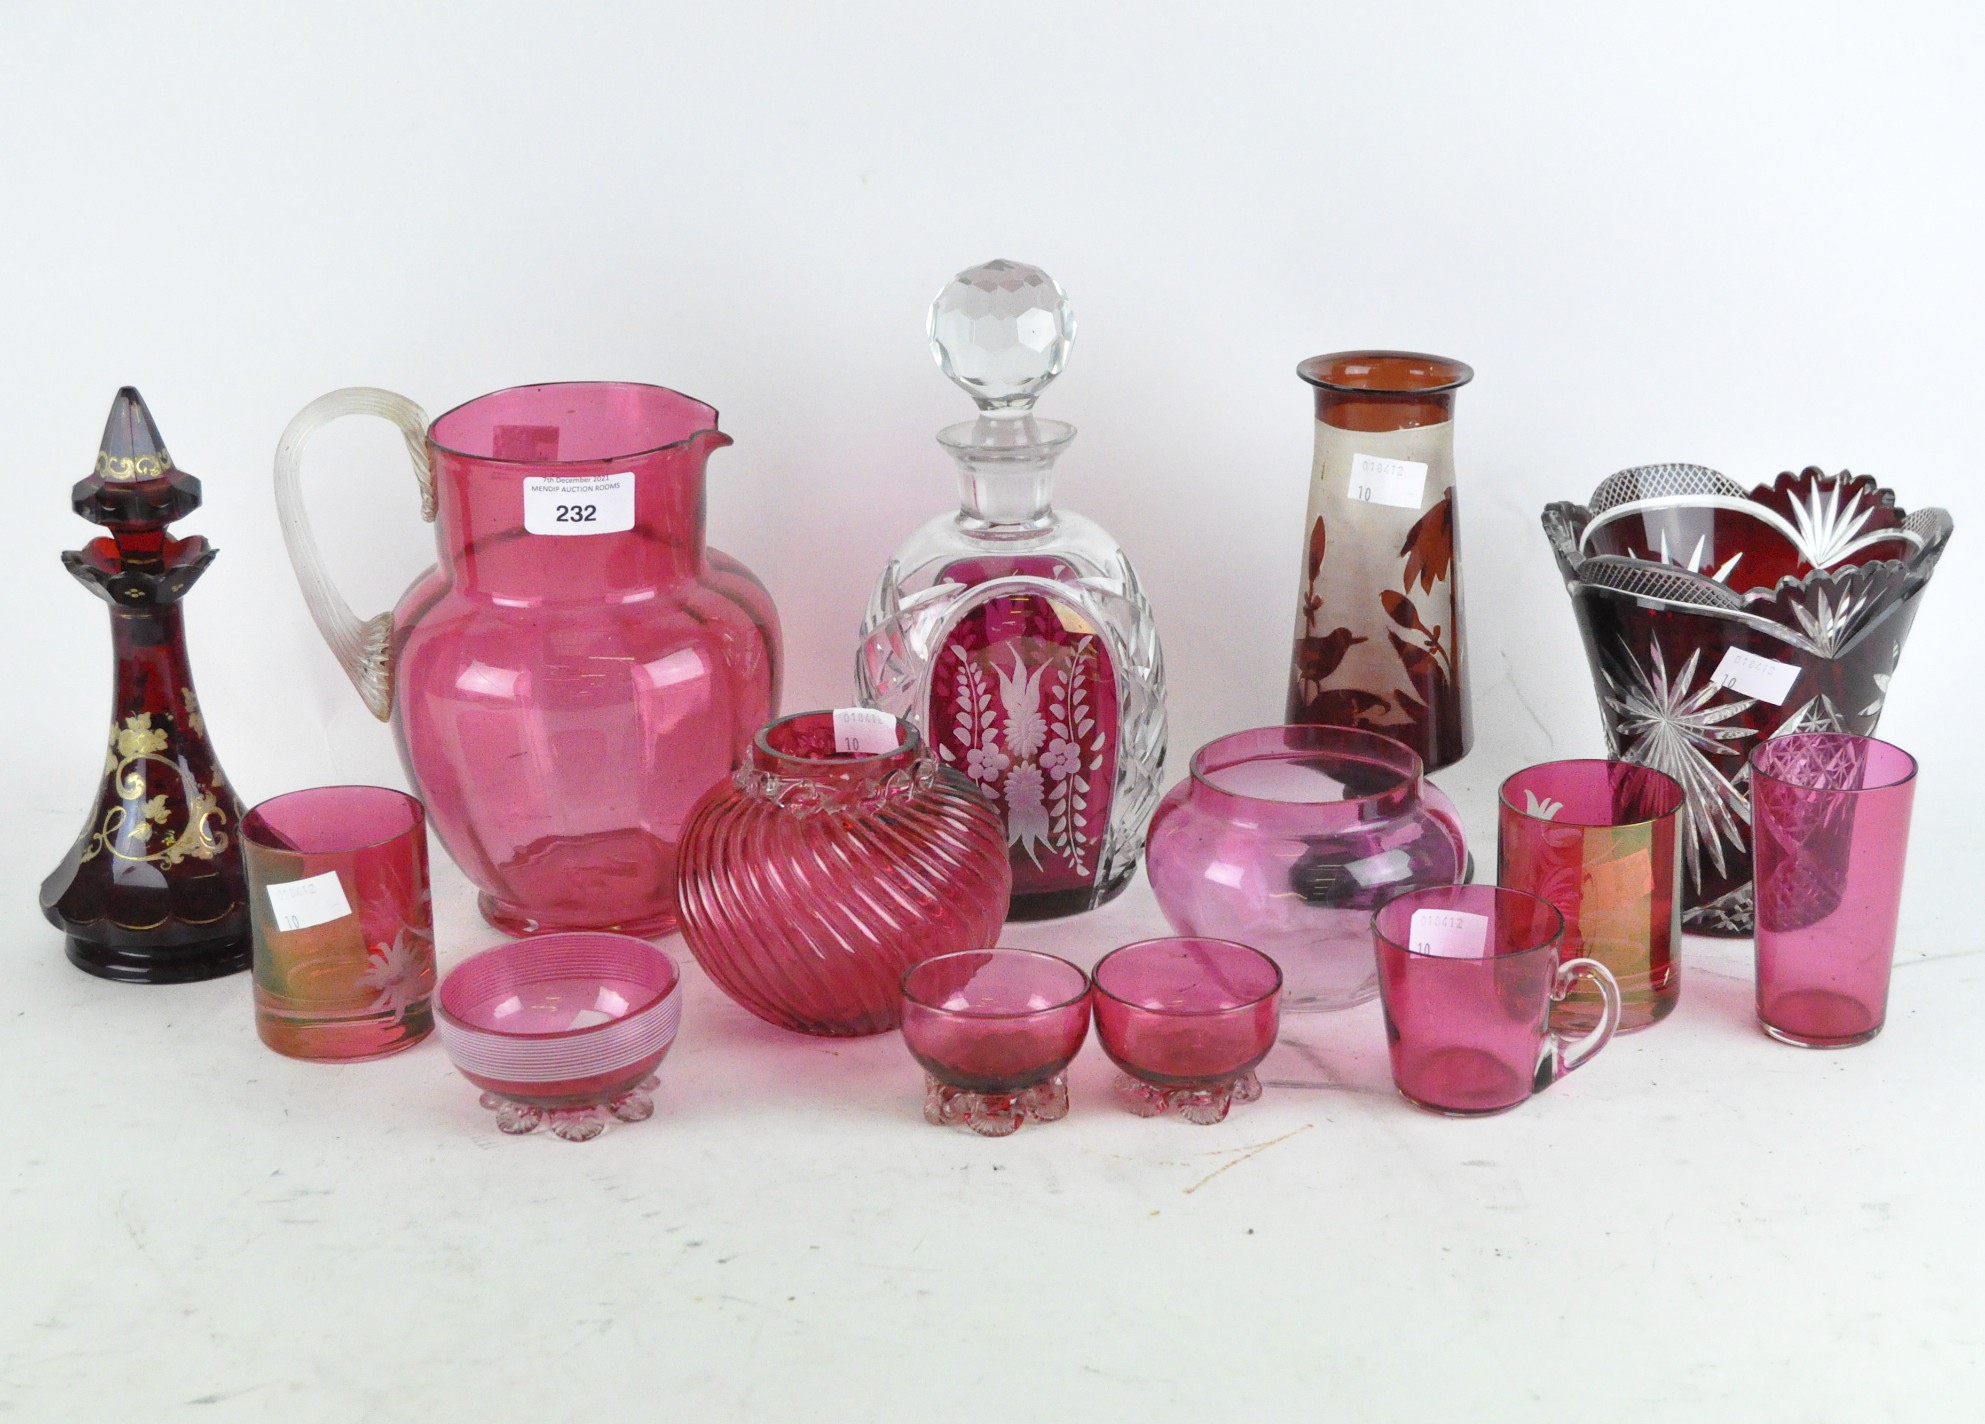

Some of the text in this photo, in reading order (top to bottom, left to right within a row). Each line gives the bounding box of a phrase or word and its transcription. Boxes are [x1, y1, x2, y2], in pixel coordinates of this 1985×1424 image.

[556, 476, 592, 484] December
[531, 482, 621, 493] MENDIP AUCTION ROOMS
[1358, 485, 1371, 502] 10
[556, 504, 597, 523] 232
[1721, 673, 1737, 689] 10
[844, 737, 860, 751] 10
[284, 914, 300, 929] 10
[1417, 942, 1431, 956] 10
